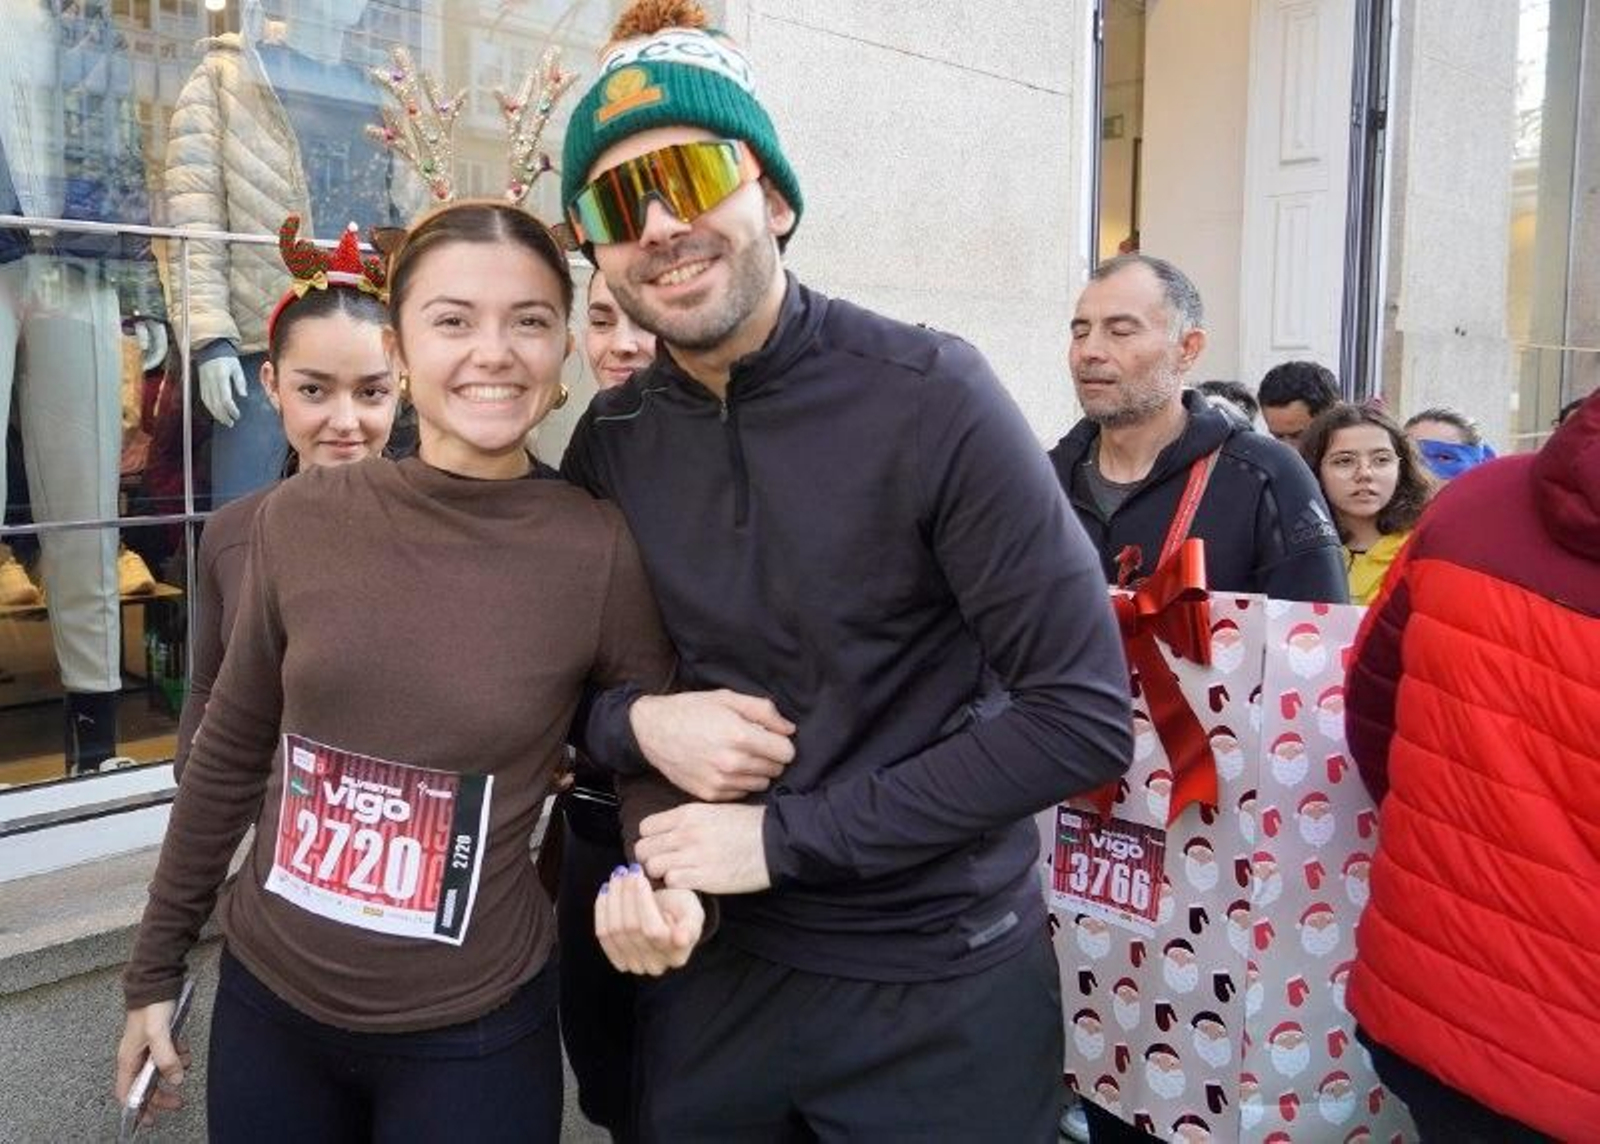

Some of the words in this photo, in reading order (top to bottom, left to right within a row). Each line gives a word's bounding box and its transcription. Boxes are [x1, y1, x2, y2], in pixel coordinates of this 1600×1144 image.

[322, 780, 411, 824] vigo
[291, 808, 422, 900] 2720
[452, 835, 473, 868] 2720
[1069, 853, 1151, 911] 3766
